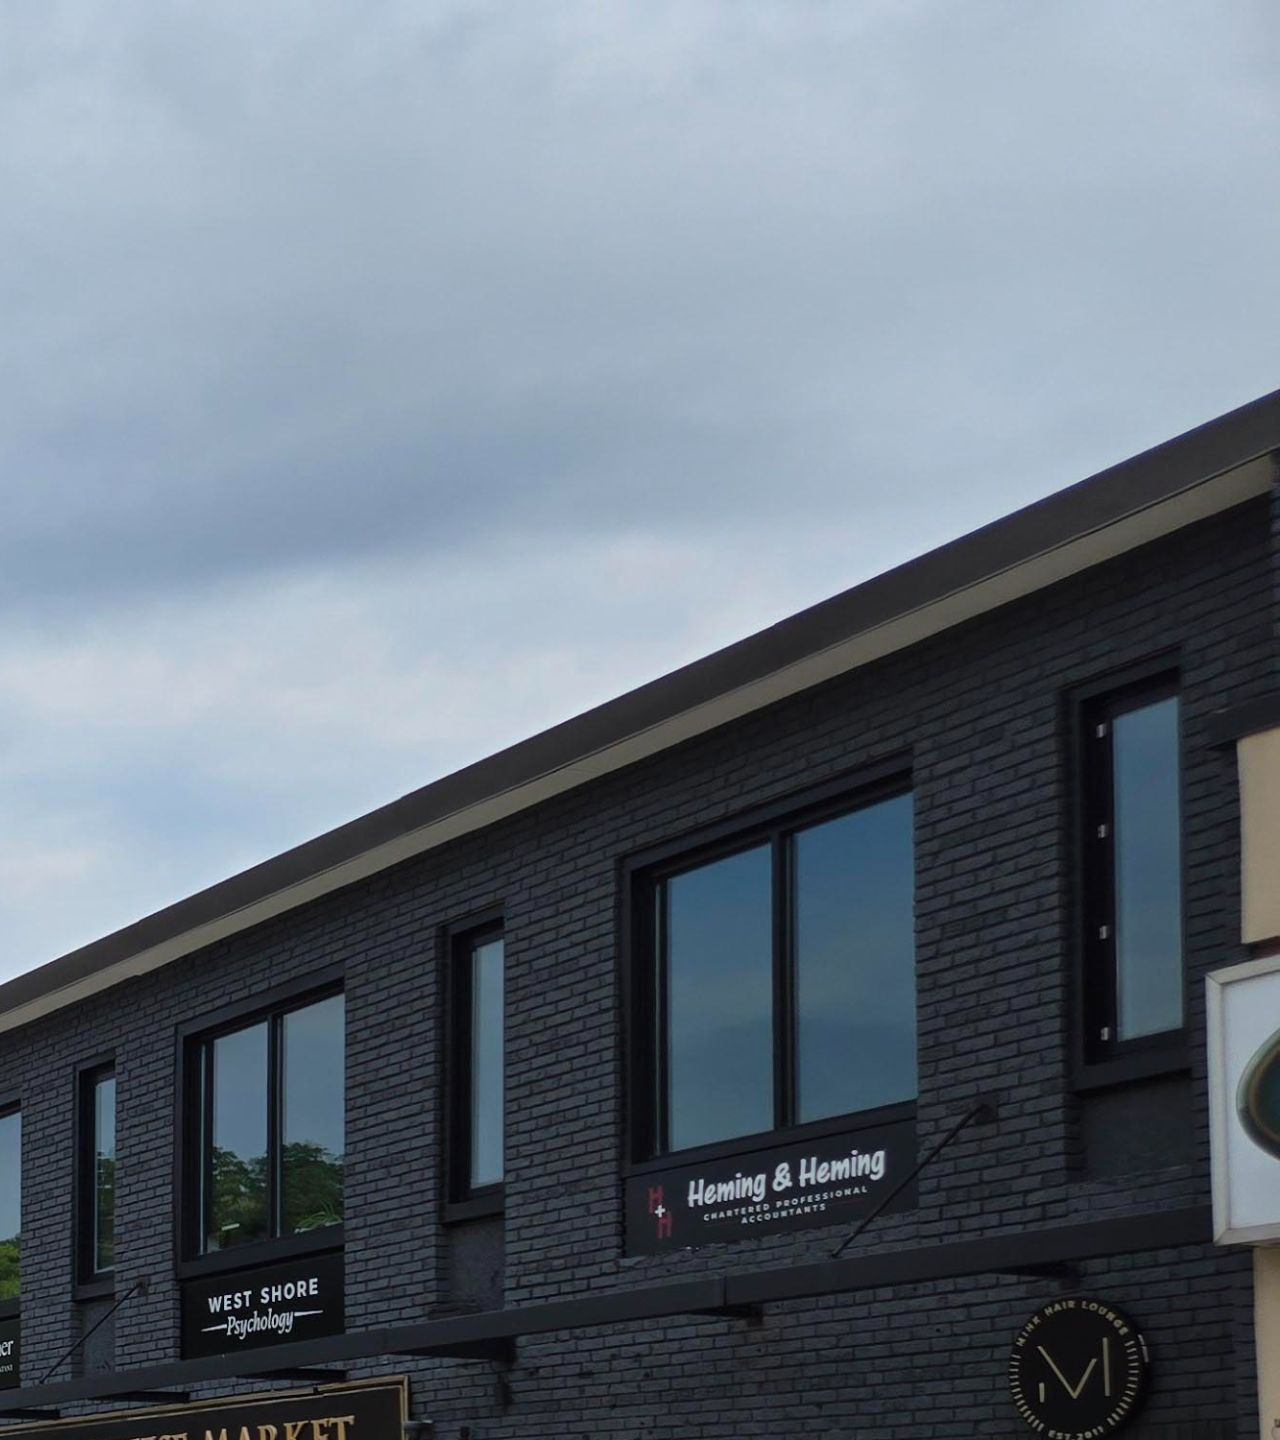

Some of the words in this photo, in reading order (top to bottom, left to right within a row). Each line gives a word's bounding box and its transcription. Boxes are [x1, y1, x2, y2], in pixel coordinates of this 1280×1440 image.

[688, 1173, 766, 1207] Heming
[772, 1163, 793, 1191] &
[798, 1150, 886, 1187] Heming
[703, 1204, 770, 1222] CHARTERED
[776, 1186, 868, 1208] PROFESSIONAL
[741, 1203, 827, 1224] ACCOUNTANTS
[208, 1290, 252, 1313] WEST
[260, 1278, 319, 1304] SHORE
[226, 1308, 294, 1340] Psychology
[1016, 1316, 1040, 1346] MINK
[1044, 1300, 1076, 1316] HAIR
[1081, 1301, 1129, 1336] LOUNGE
